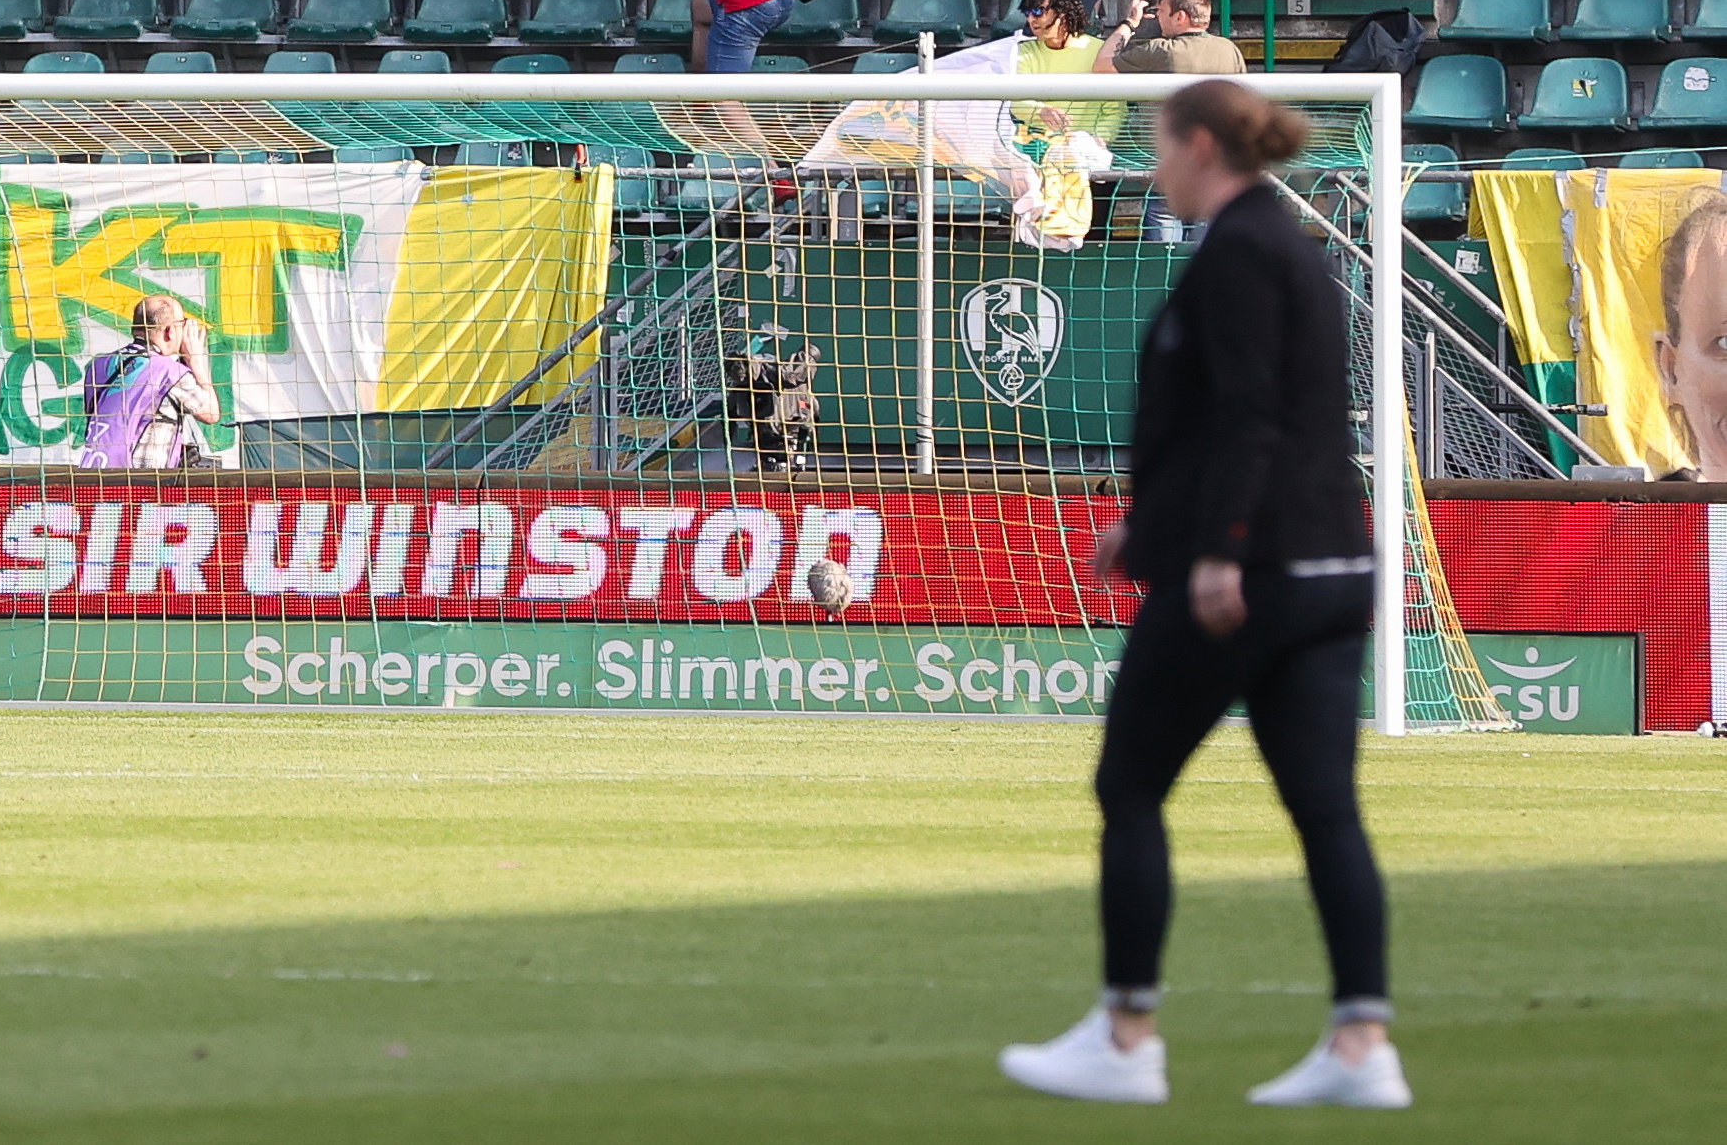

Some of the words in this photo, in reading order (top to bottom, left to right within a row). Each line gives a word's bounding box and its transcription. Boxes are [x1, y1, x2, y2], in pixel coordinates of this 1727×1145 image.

[1291, 0, 1307, 16] 5
[241, 634, 573, 708] Scherper.
[595, 638, 891, 704] Slimmer.
